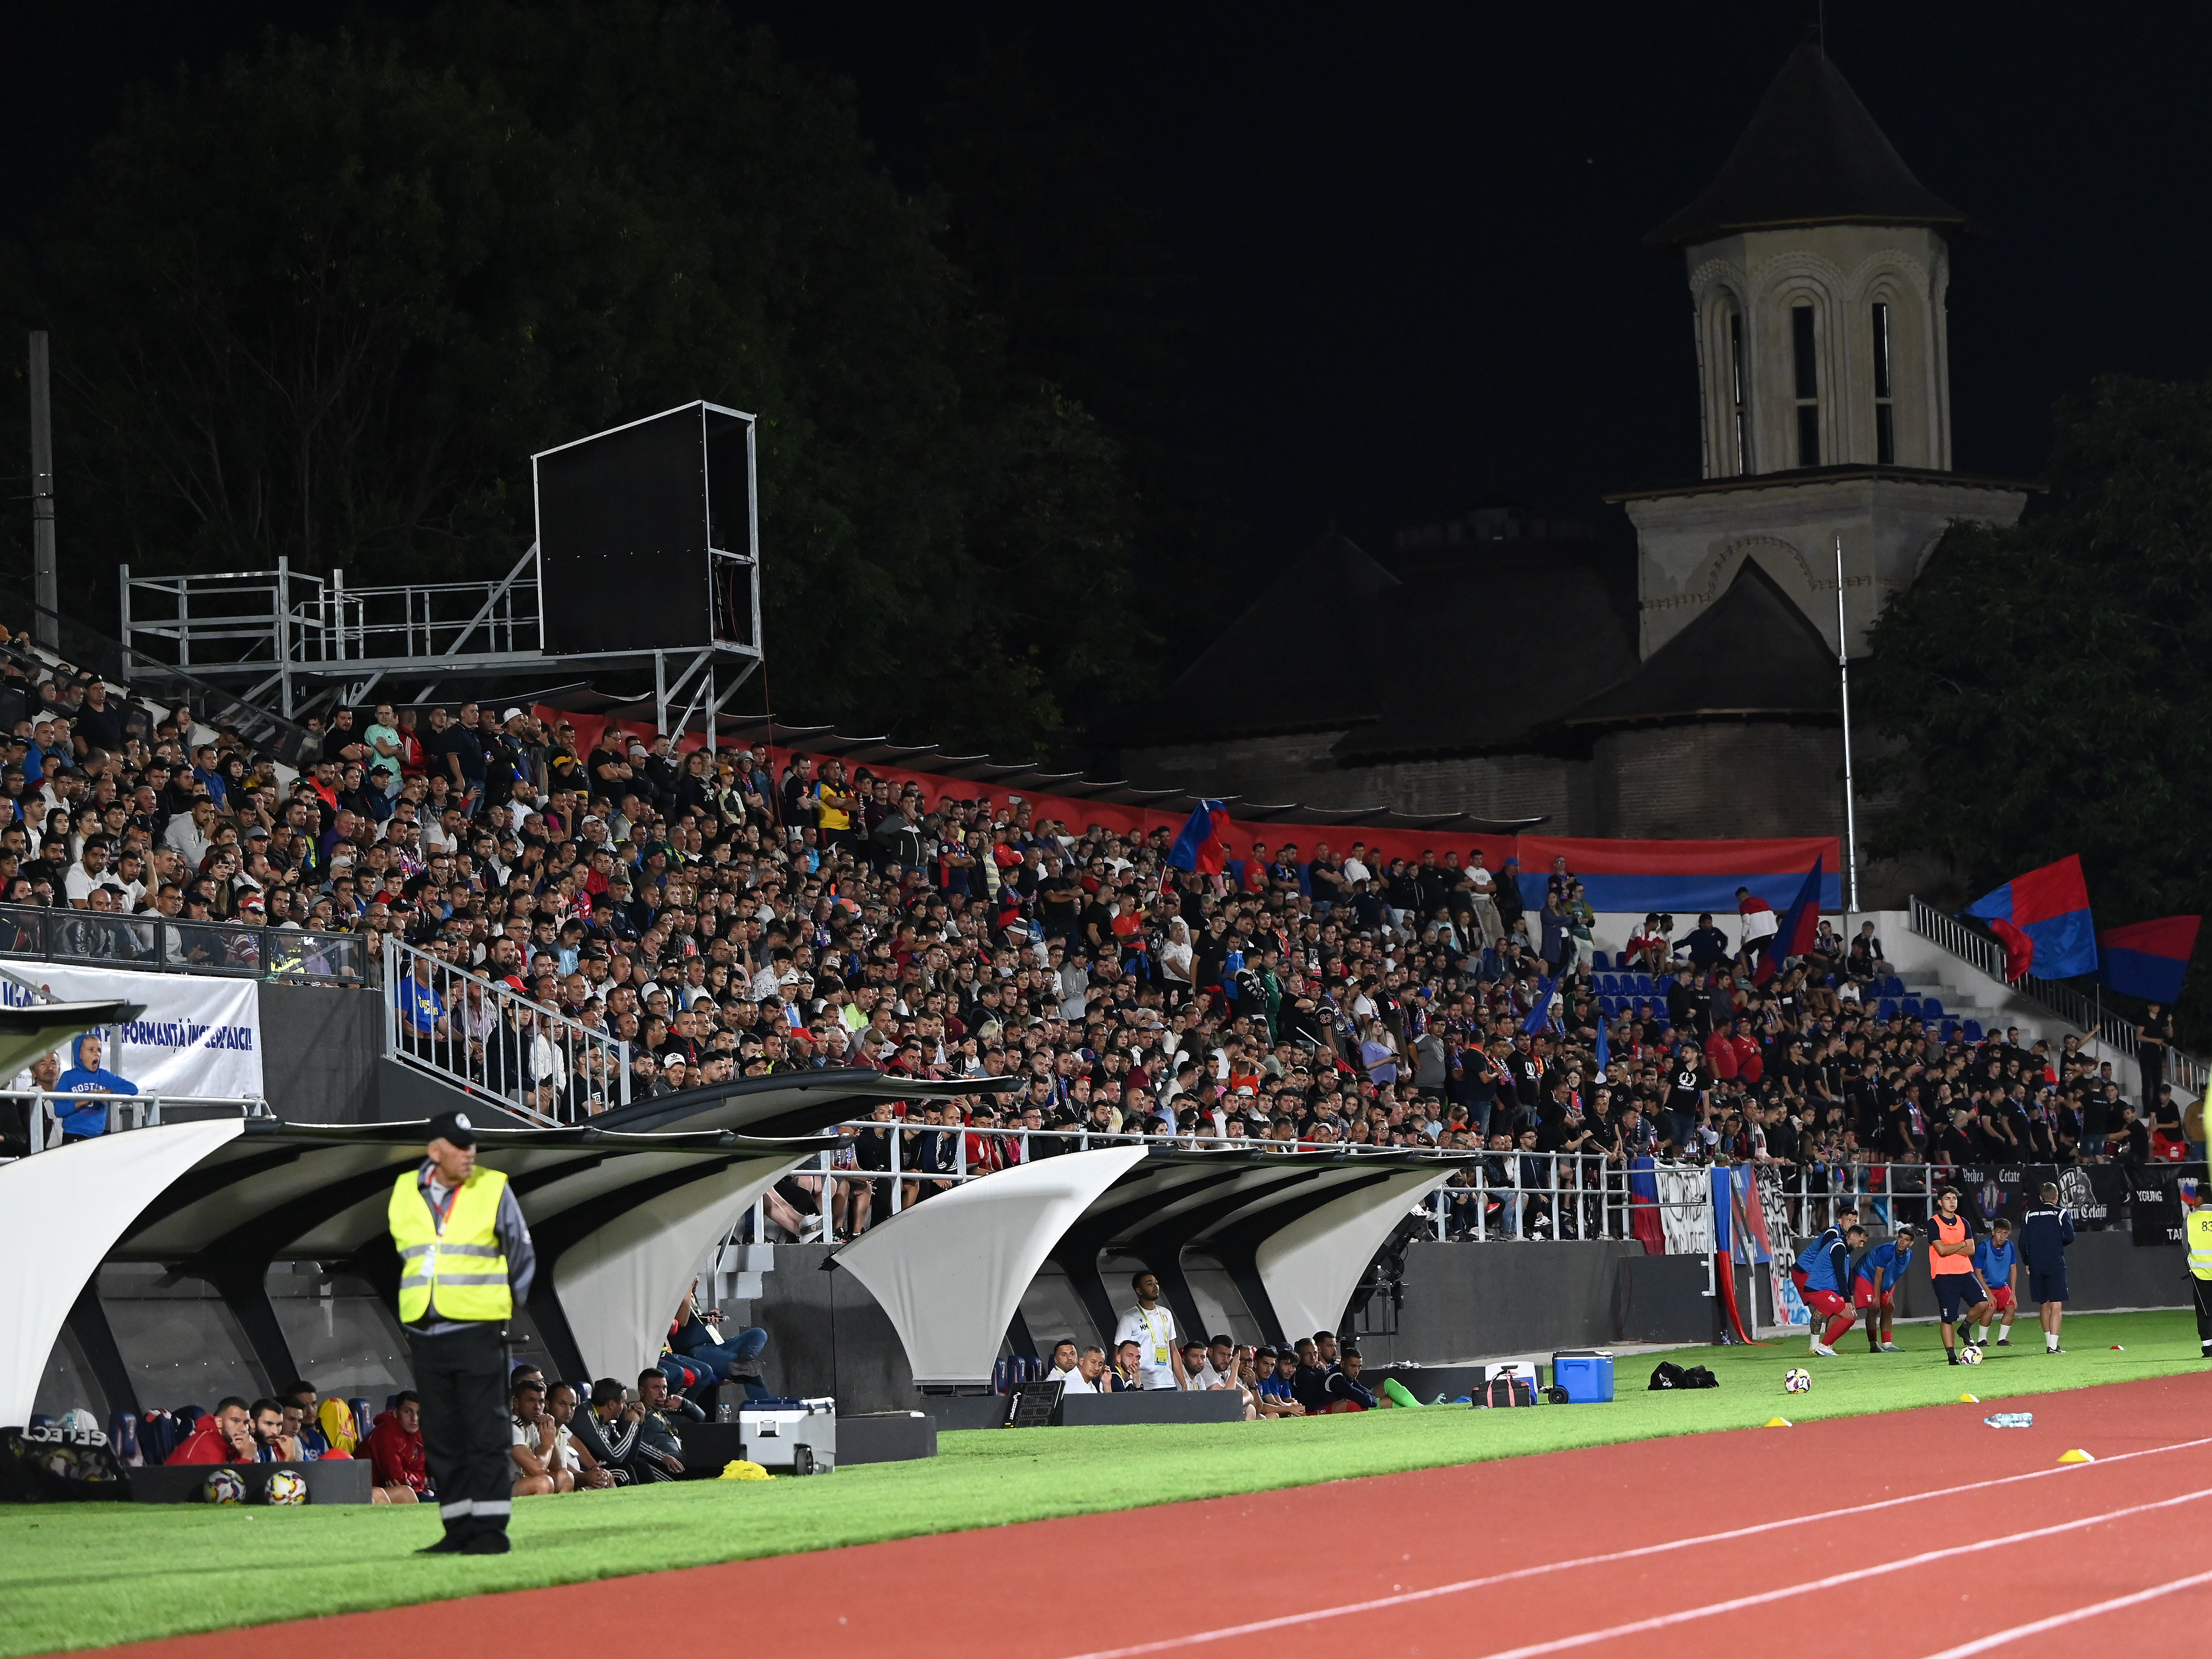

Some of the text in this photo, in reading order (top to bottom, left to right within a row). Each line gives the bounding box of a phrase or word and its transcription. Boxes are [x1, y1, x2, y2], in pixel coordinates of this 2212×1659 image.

[1320, 1014, 1332, 1024] 23
[226, 1027, 253, 1051] AICI!
[1999, 1168, 2020, 1183] Cetate
[2136, 1190, 2163, 1202] YOUNG
[20, 1426, 107, 1447] SELECT
